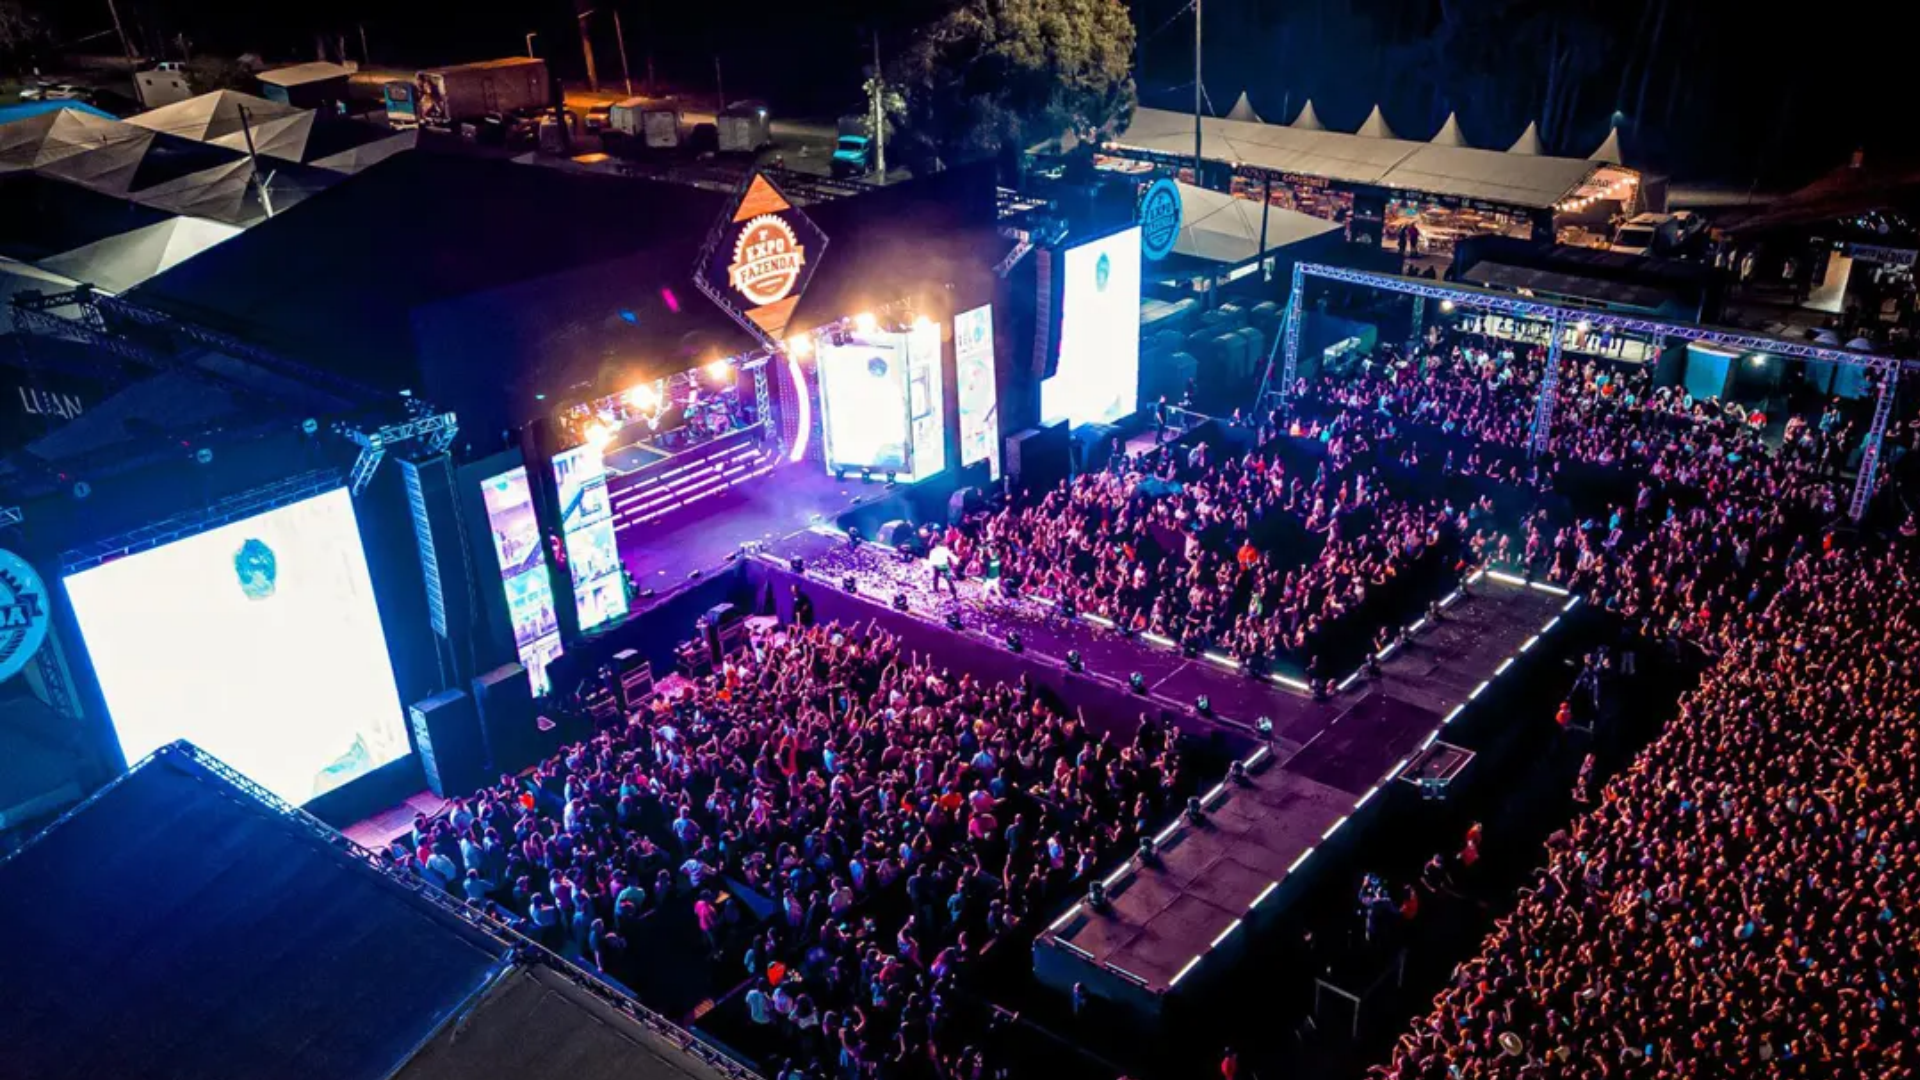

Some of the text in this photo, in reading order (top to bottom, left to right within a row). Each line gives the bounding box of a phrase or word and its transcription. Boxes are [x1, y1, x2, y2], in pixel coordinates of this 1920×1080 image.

[1149, 202, 1173, 221] EXPO
[746, 238, 785, 261] EXPO
[740, 257, 797, 283] FAZENDA
[19, 386, 82, 419] LUAN
